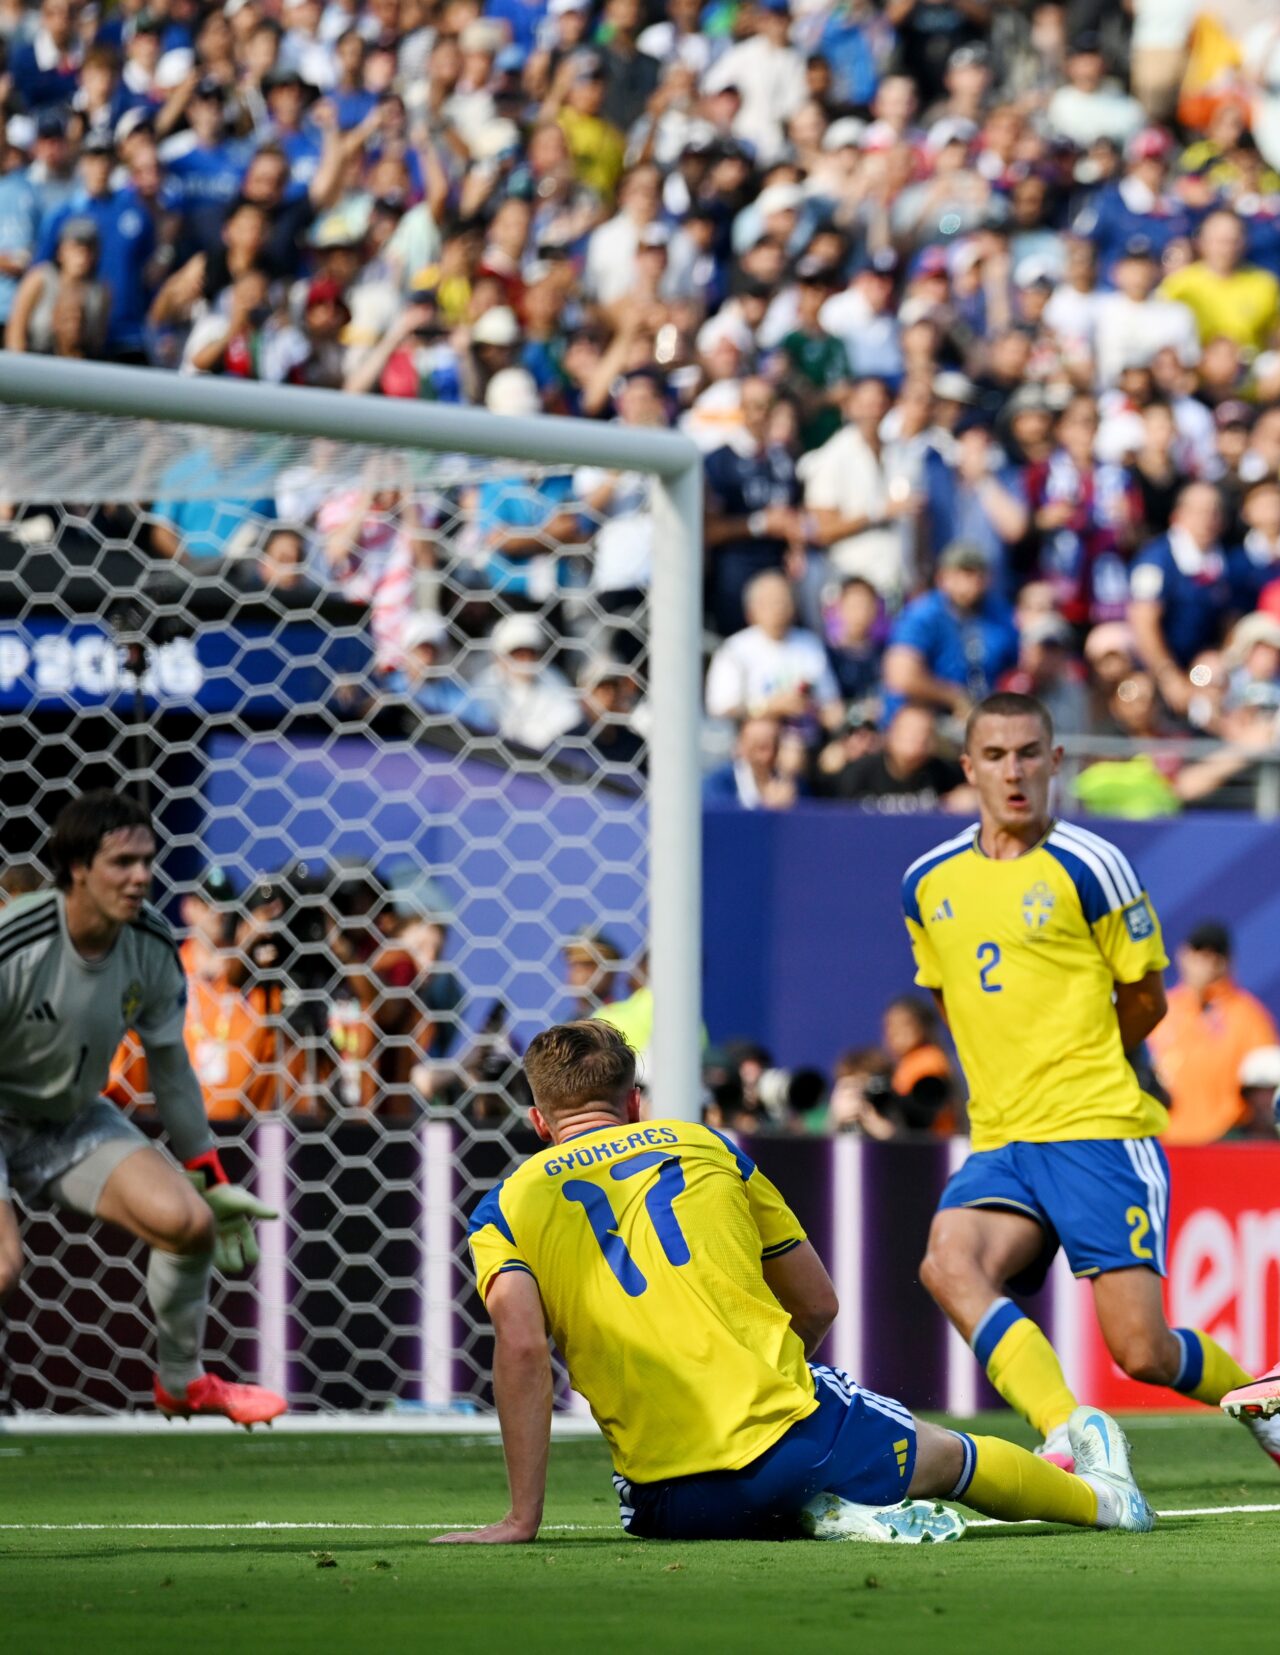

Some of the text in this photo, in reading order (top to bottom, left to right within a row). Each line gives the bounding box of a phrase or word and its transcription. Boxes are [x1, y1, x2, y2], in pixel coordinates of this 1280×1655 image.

[976, 942, 1003, 993] 2
[544, 1127, 679, 1177] GYÖKERES
[561, 1151, 691, 1298] 17
[1125, 1206, 1154, 1259] 2
